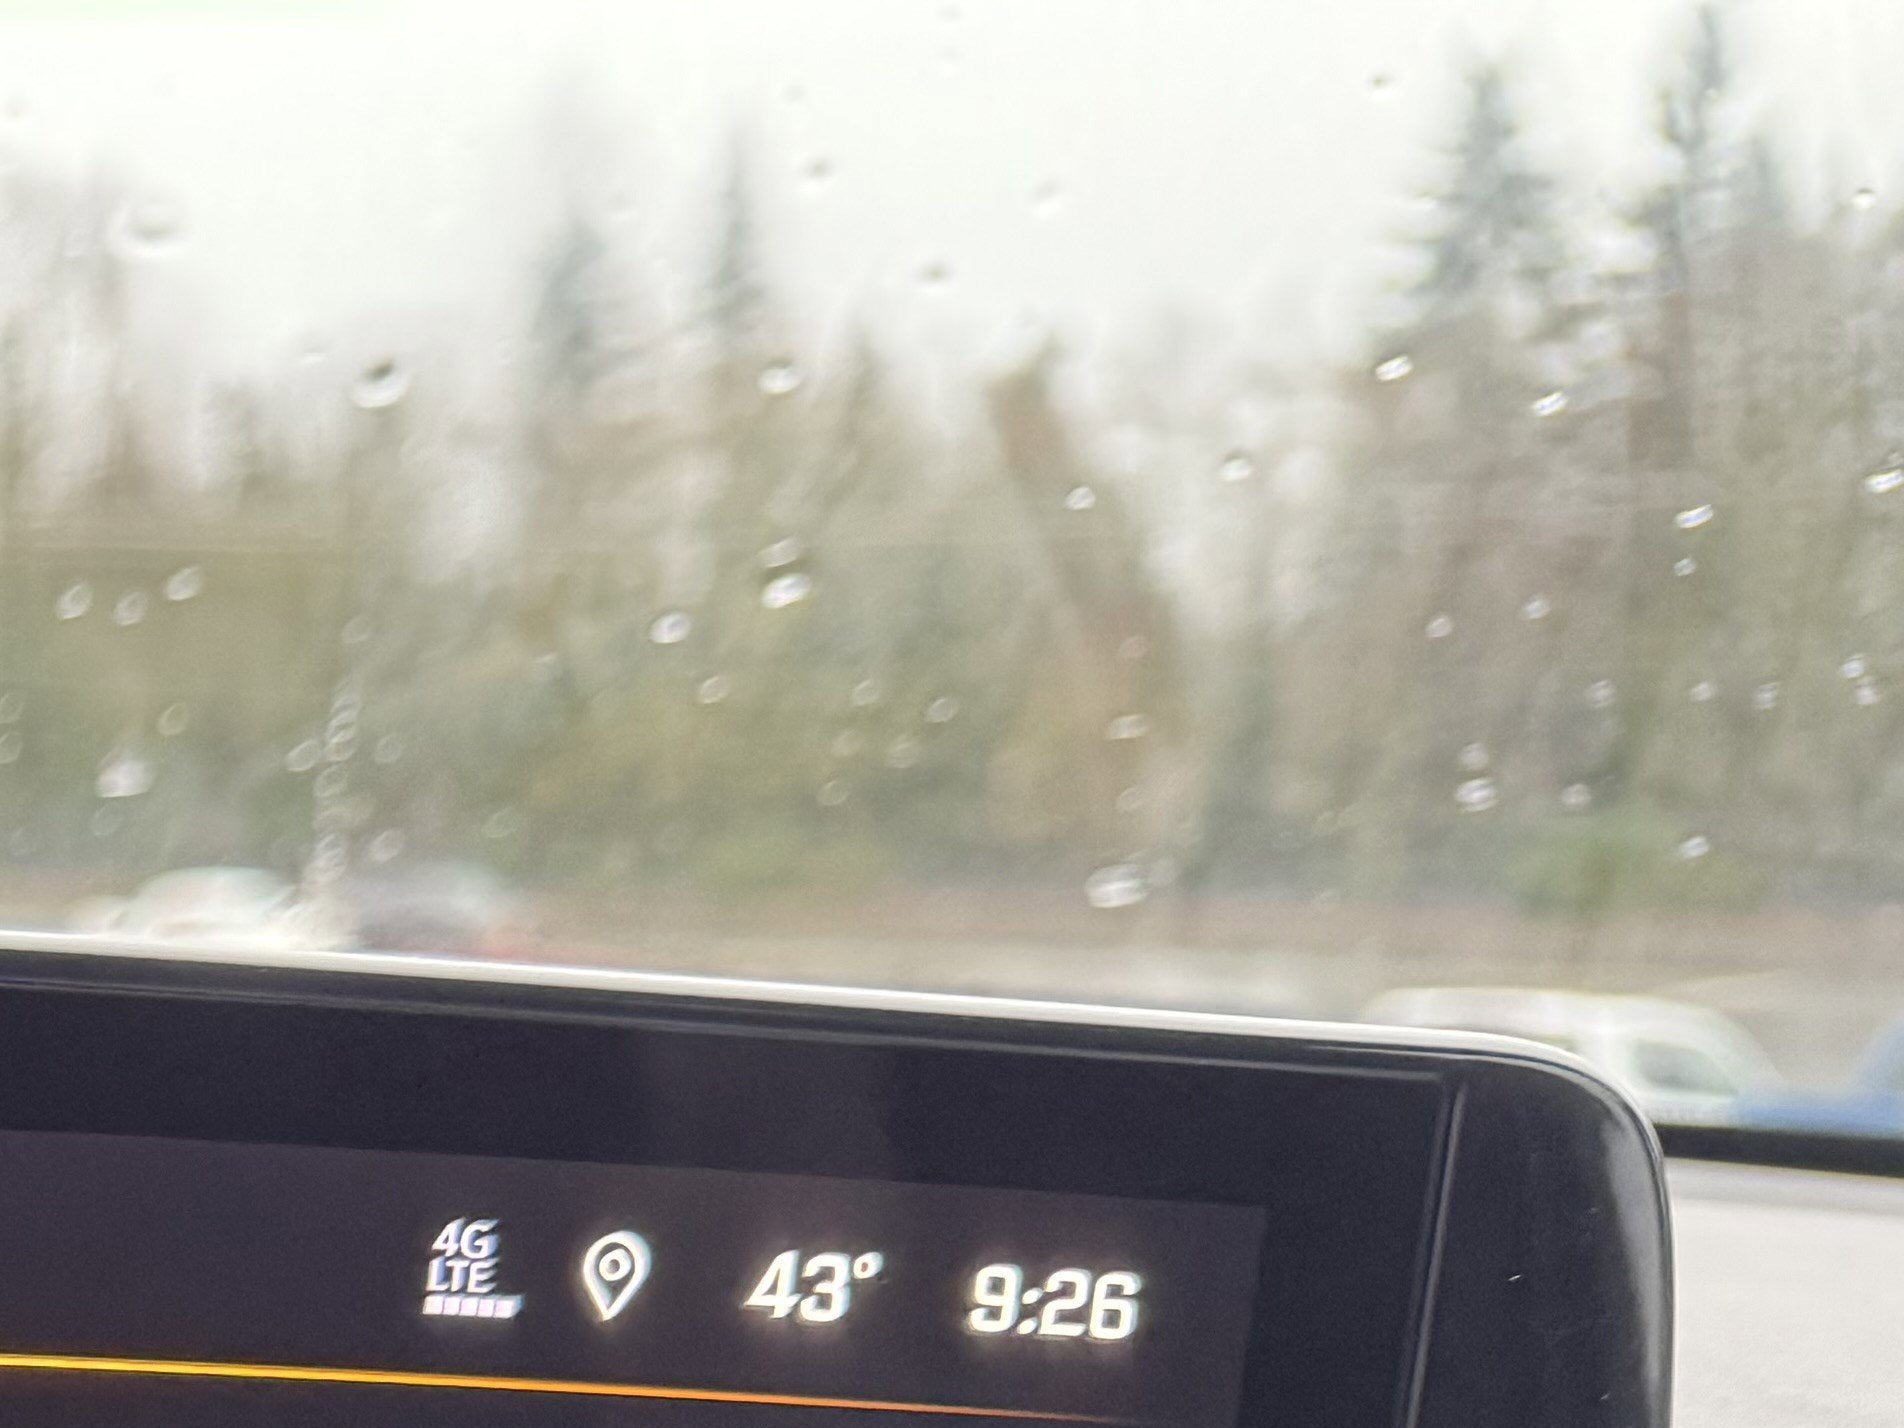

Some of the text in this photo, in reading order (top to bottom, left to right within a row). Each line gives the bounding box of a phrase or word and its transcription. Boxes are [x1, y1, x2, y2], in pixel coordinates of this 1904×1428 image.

[430, 1217, 497, 1259] 4G
[424, 1257, 497, 1294] LTE
[966, 1264, 1141, 1342] 9:26
